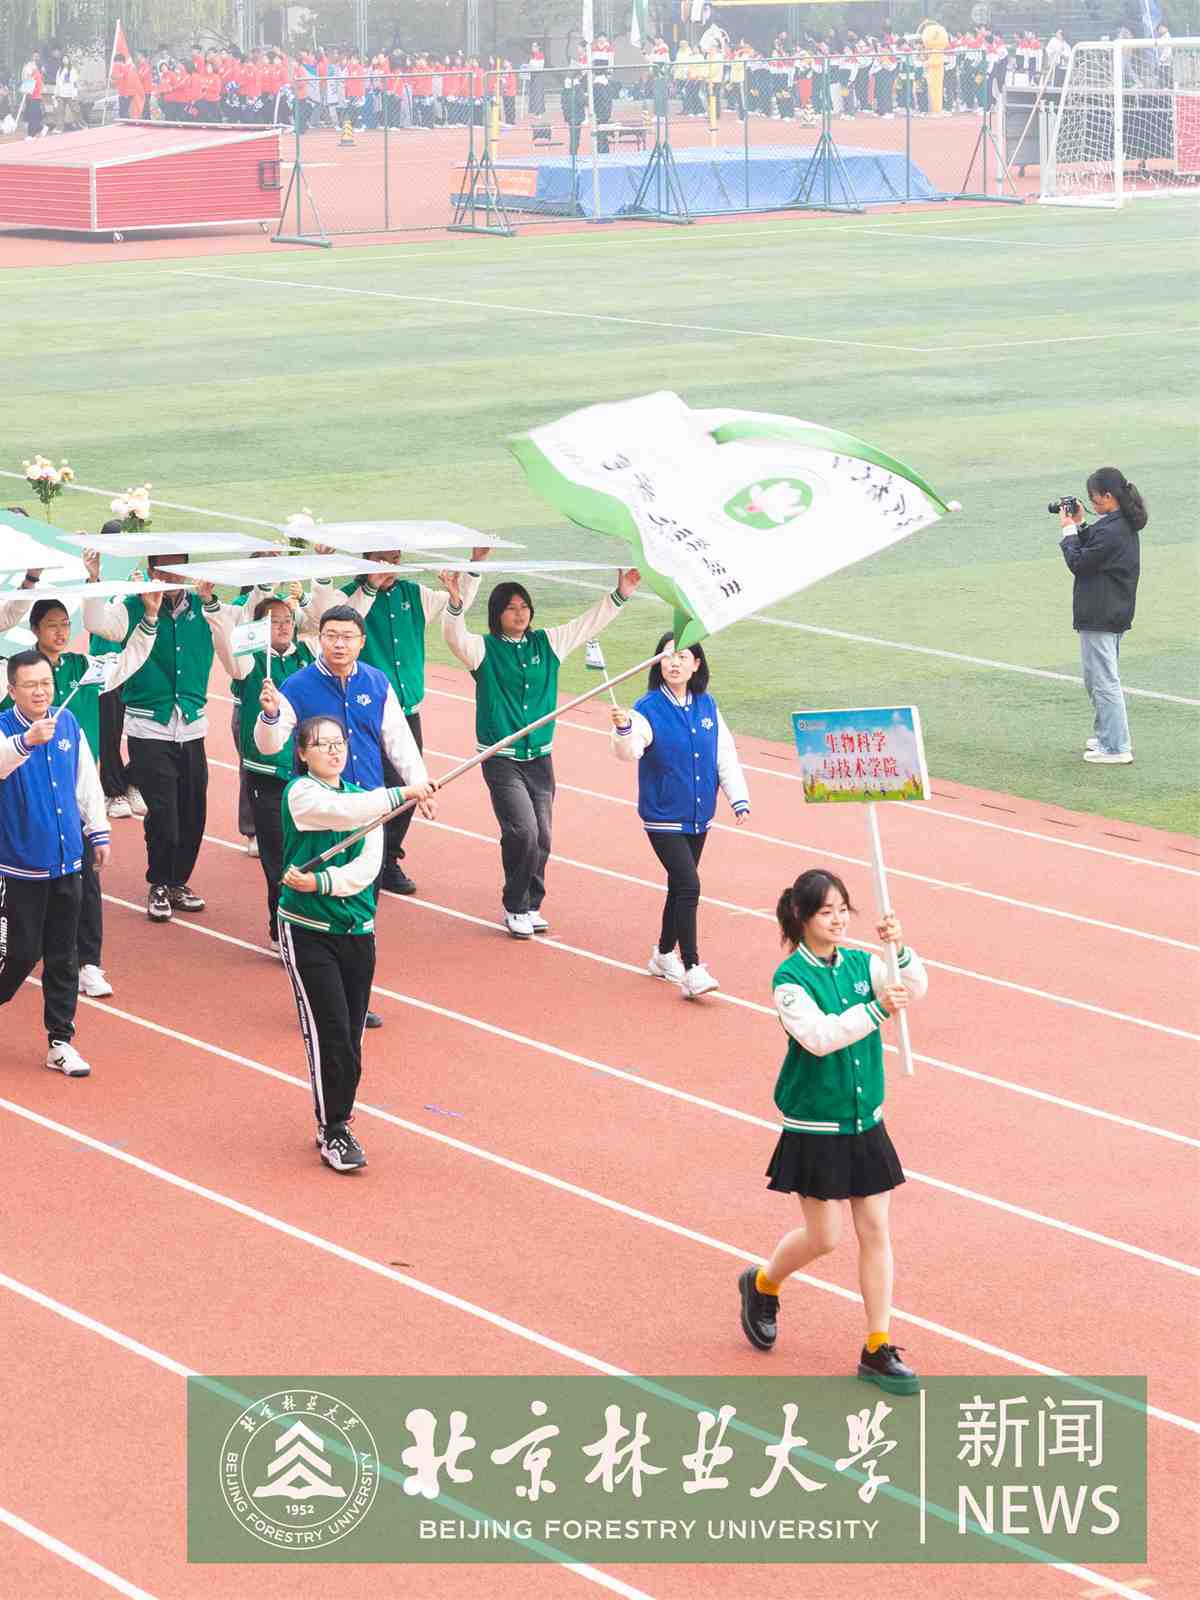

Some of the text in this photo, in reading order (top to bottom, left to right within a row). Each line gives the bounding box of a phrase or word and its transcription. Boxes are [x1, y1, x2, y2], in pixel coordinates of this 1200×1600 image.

[826, 731, 886, 753] 生物科学
[823, 756, 899, 779] 与技术学院
